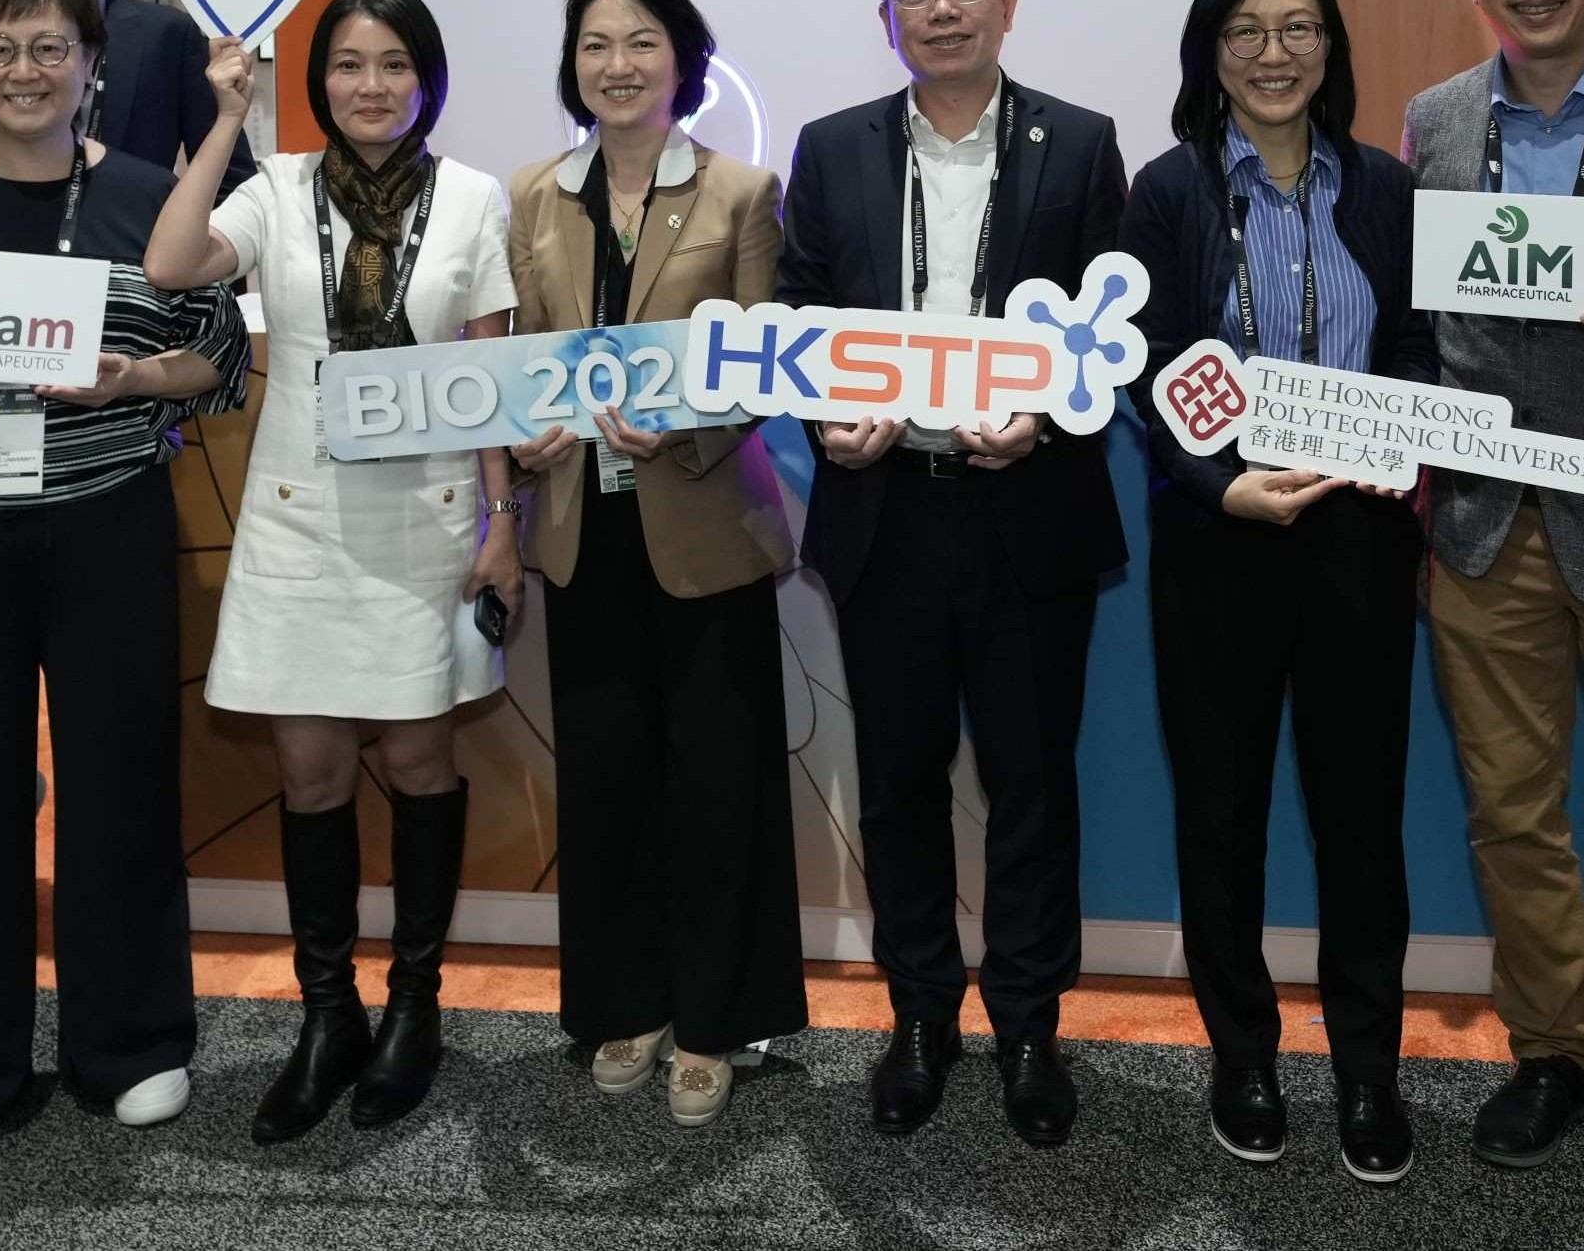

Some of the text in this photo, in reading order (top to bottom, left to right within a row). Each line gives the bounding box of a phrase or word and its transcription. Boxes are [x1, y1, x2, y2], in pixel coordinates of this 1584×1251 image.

[1456, 284, 1573, 303] PHARMACEUTICAL
[1457, 240, 1573, 288] AIM
[345, 347, 682, 437] BIO 202
[706, 320, 1053, 411] HKSTP
[1253, 395, 1445, 455] POLYTECHNIC
[1256, 367, 1495, 431] THE HONG KONG
[1248, 425, 1406, 473] 香港理工大學
